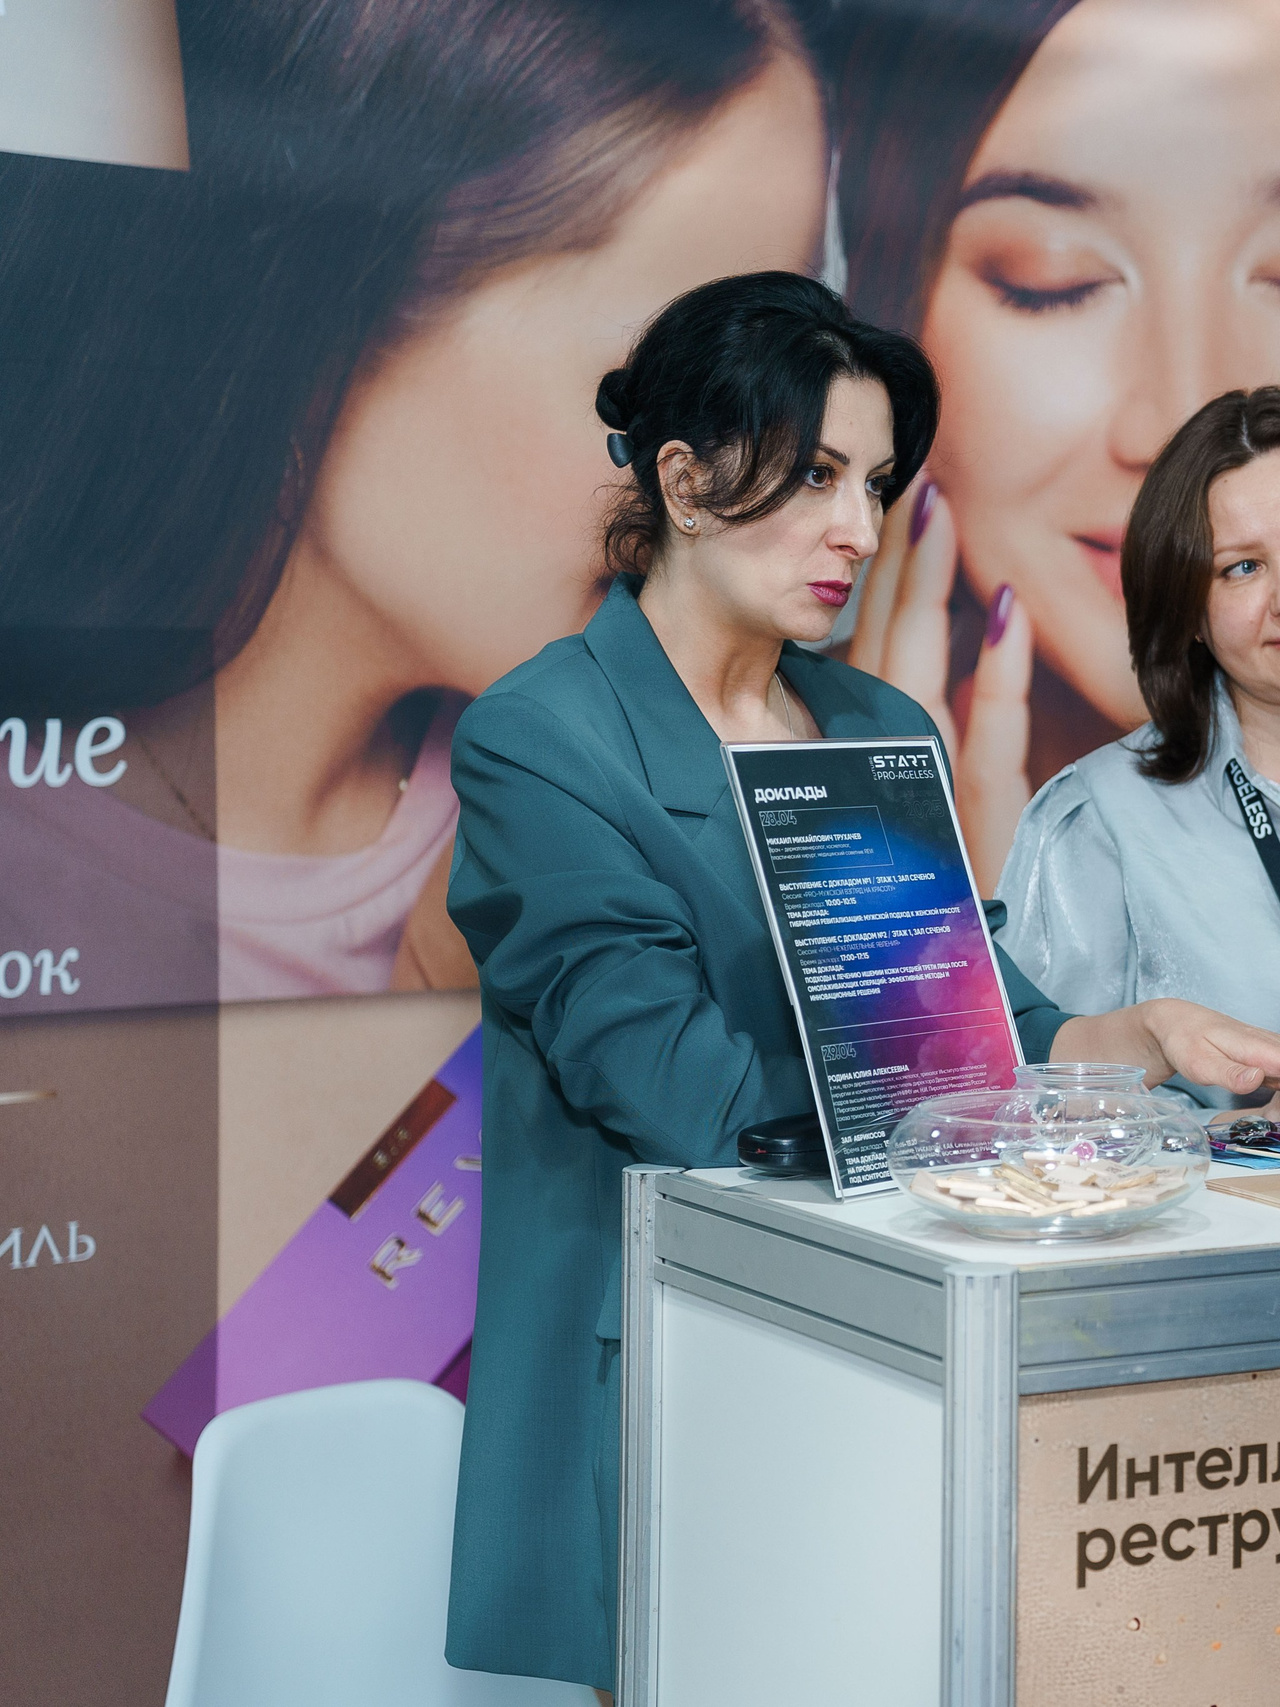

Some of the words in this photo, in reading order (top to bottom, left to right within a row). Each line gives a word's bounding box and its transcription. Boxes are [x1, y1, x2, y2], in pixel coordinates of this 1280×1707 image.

[873, 754, 930, 767] START
[877, 769, 934, 780] PRO-AGELESS
[753, 786, 828, 803] ДОКЛАДЫ
[759, 810, 797, 826] 28.04
[766, 837, 792, 845] МИХАИЛ
[792, 833, 833, 843] МИХАЙЛОВИЧ
[833, 833, 862, 841] ТРУХАЧЕВ
[779, 881, 822, 891] ВЫСТУПЛЕНИЕ
[822, 880, 828, 888] С
[827, 878, 862, 887] ДОКЛАДОМ
[862, 877, 871, 885] №1
[875, 876, 893, 884] ЭТАЖ
[909, 873, 936, 881] СЕЧЕНОВ
[784, 902, 801, 910] Время
[825, 897, 857, 906] 10:00-10:15
[786, 911, 801, 919] ТЕМА
[802, 909, 829, 917] ДОКЛАДА:
[789, 918, 820, 927] ГИБРИДНАЯ
[863, 913, 889, 921] МУЖСКОЙ
[889, 911, 911, 919] ПОДХОД
[914, 908, 939, 916] ЖЕНСКОЙ
[939, 906, 961, 914] КРАСОТЕ
[794, 936, 837, 946] ВЫСТУПЛЕНИЕ
[837, 935, 843, 943] С
[842, 932, 877, 942] ДОКЛАДОМ
[877, 931, 887, 939] №2
[891, 929, 908, 938] ЭТАЖ
[913, 928, 926, 936] ЗАЛ
[925, 926, 951, 935] СЕЧЕНОВ
[840, 952, 870, 962] 17:00-17:15
[805, 974, 832, 983] ПОДХОДЫ
[836, 971, 861, 980] ЛЕЧЕНИЮ
[861, 969, 884, 977] ИШЕМИИ
[884, 967, 899, 975] КОЖИ
[899, 965, 922, 973] СРЕДНЕЙ
[951, 960, 968, 968] ПОСЛЕ
[817, 964, 844, 973] ДОКЛАДА:
[807, 981, 859, 992] ОМОЛАЖИВАЮЩИХ
[888, 974, 924, 984] ЭФФЕКТИВНЫЕ
[924, 972, 945, 980] МЕТОДЫ
[809, 990, 856, 1001] ИННОВАЦИОННЫЕ
[857, 988, 881, 996] РЕШЕНИЯ
[821, 1042, 857, 1061] 29.04
[828, 1072, 852, 1082] РОДИНА
[853, 1070, 872, 1079] ЮЛИЯ
[872, 1065, 909, 1076] АЛЕКСЕЕВНА
[853, 1131, 885, 1141] АБРИКОСОВ
[845, 1157, 860, 1165] ТЕМА
[849, 1175, 862, 1184] ПОД
